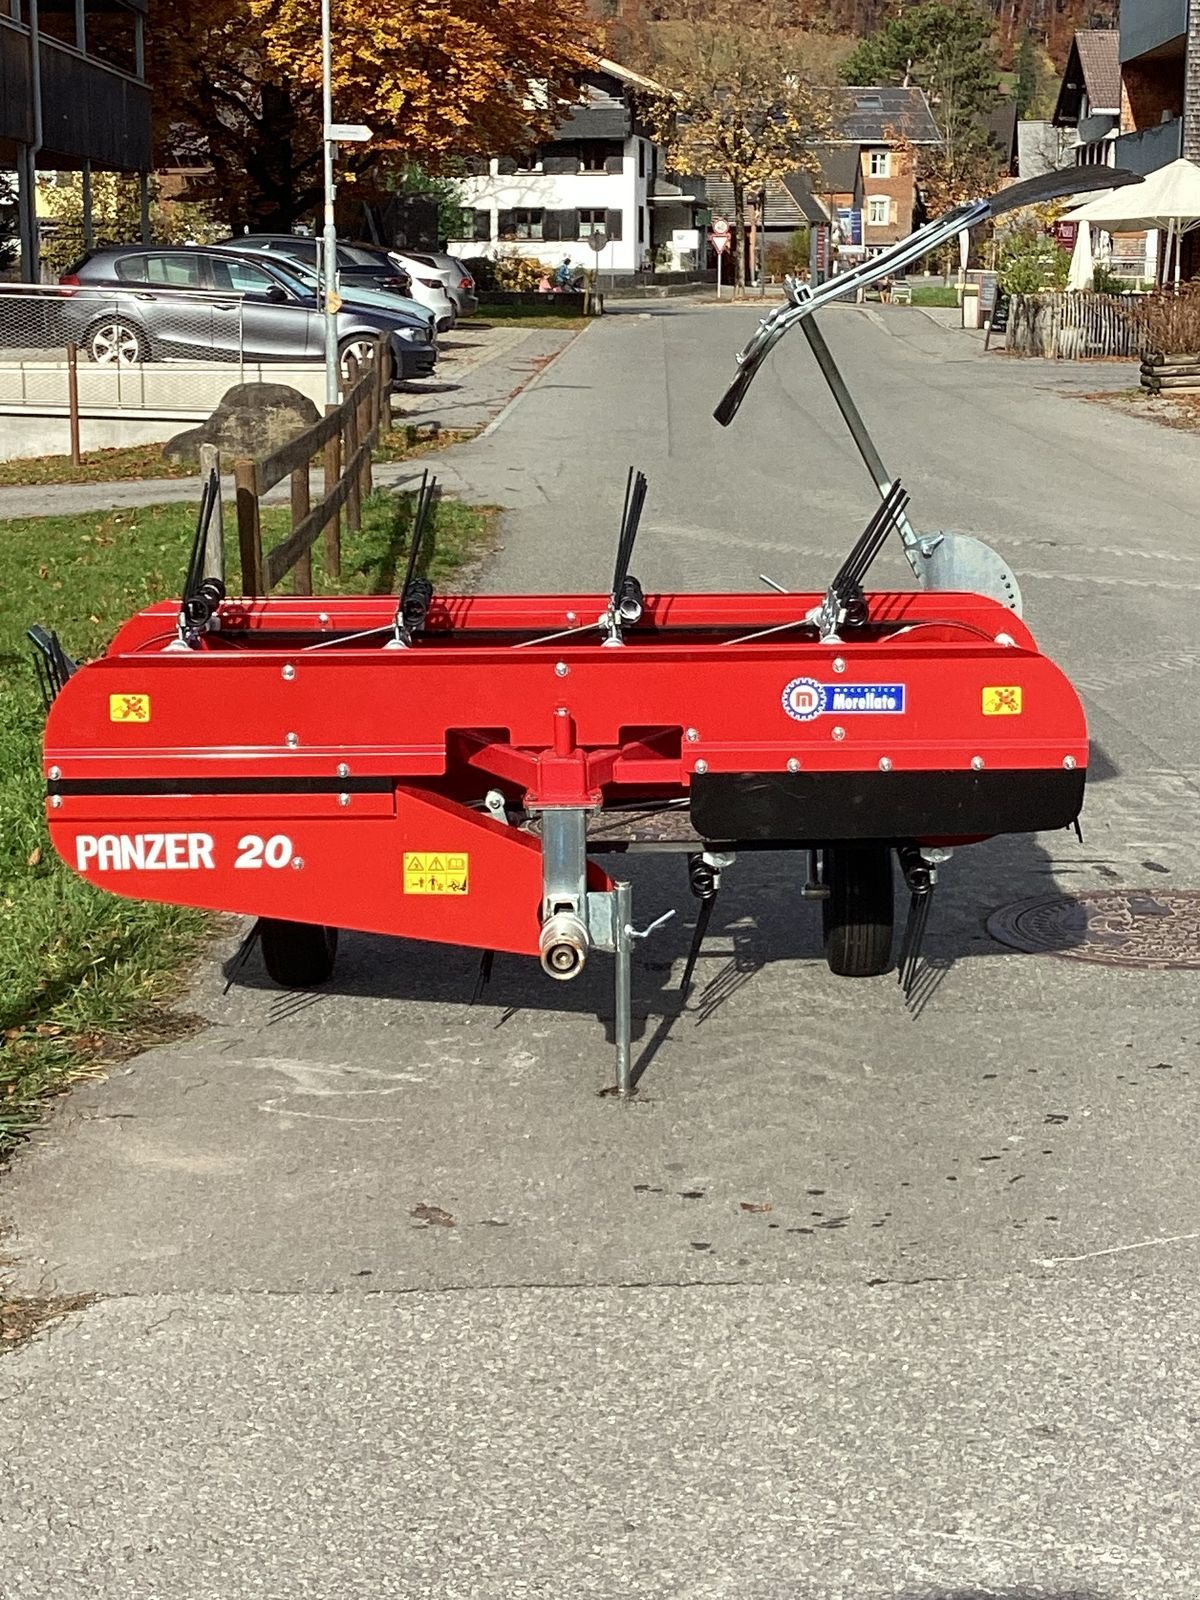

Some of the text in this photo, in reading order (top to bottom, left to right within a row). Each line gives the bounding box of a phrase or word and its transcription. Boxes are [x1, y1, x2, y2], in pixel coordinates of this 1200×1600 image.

[833, 692, 896, 710] Morellato
[76, 833, 293, 871] PANZER 20
